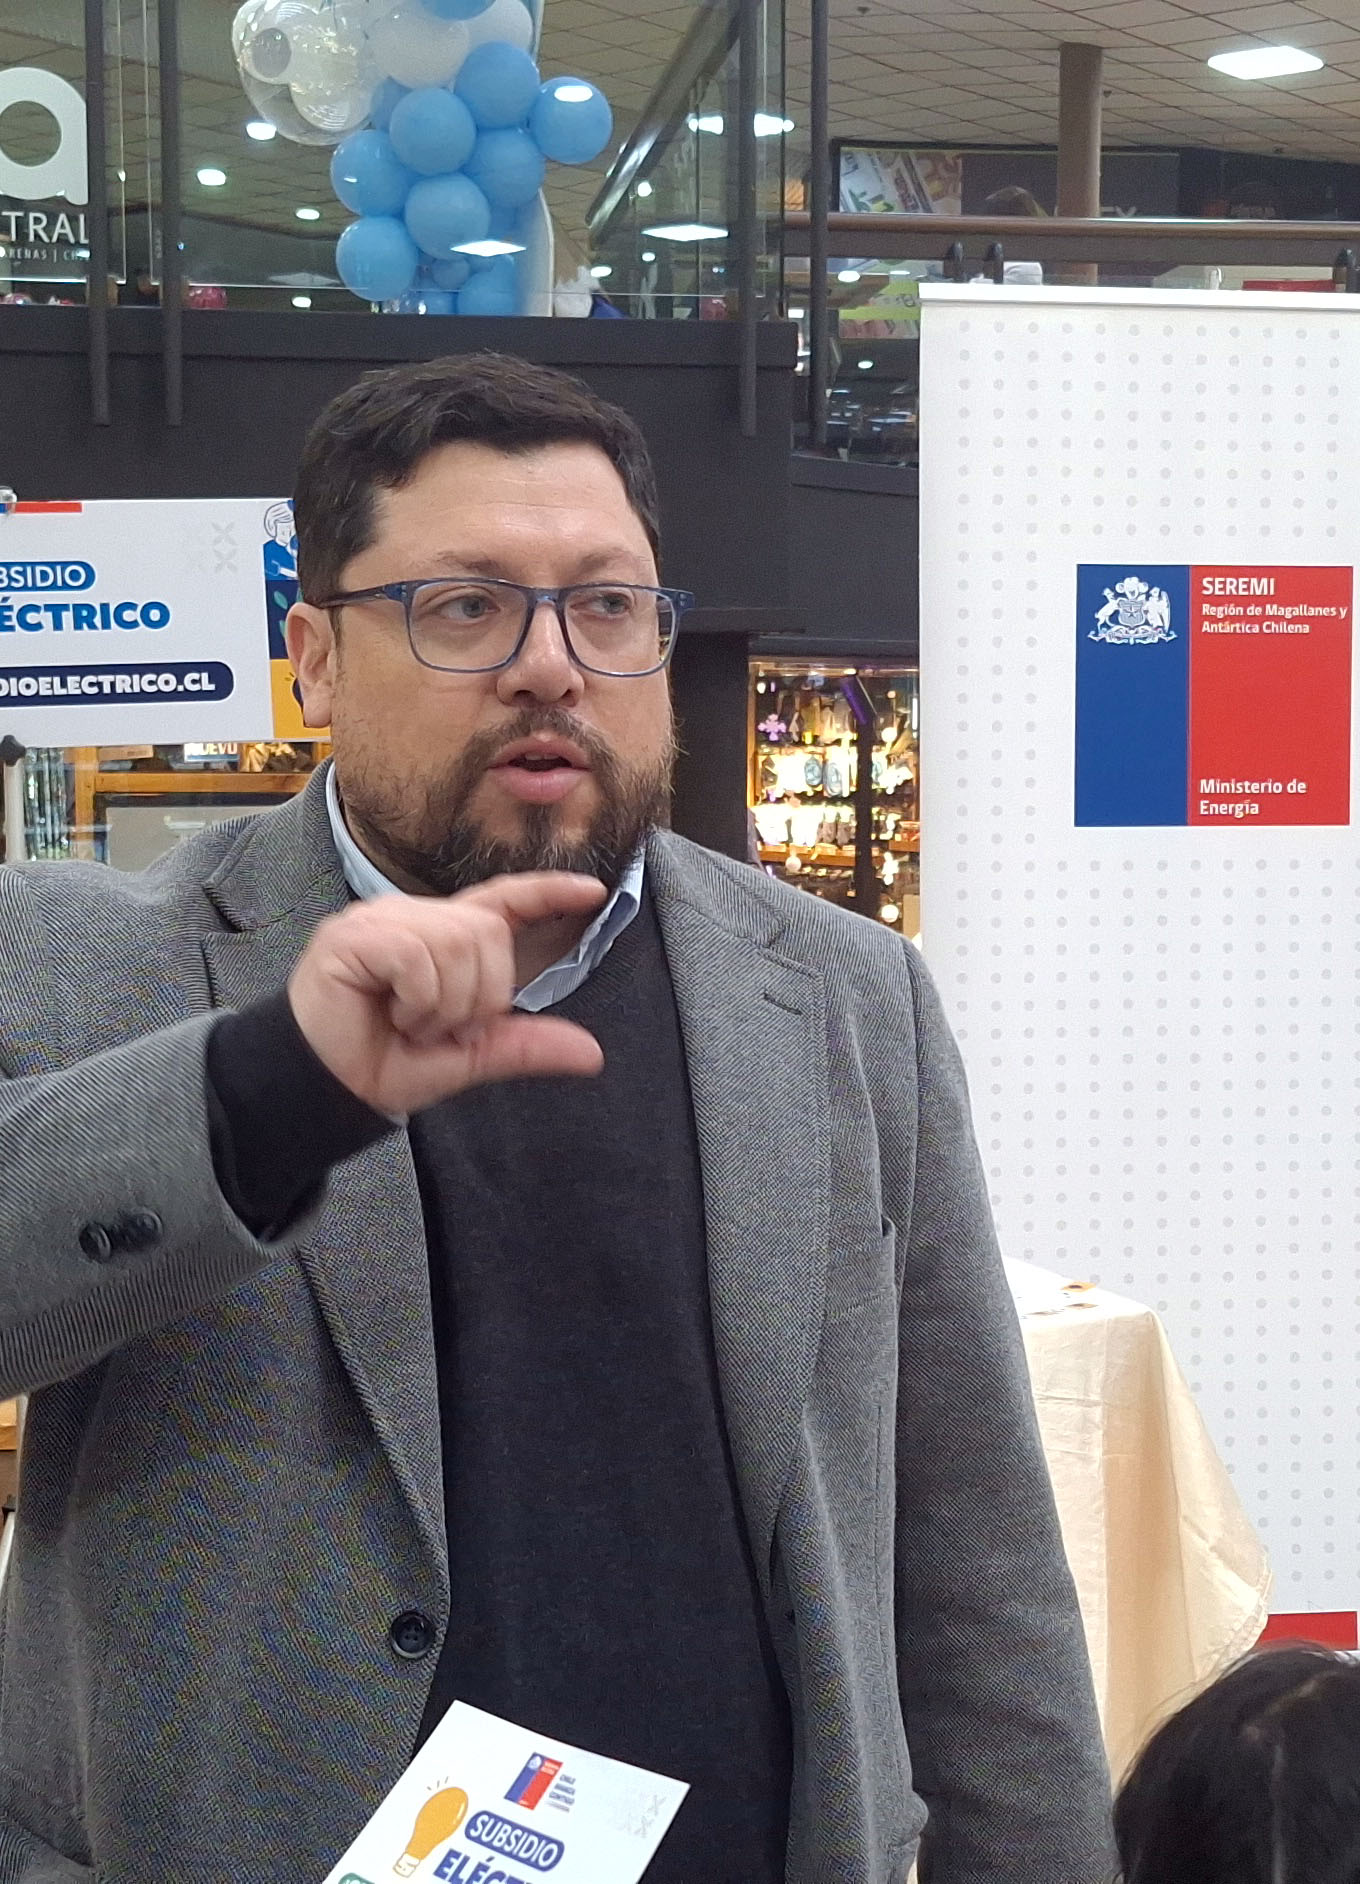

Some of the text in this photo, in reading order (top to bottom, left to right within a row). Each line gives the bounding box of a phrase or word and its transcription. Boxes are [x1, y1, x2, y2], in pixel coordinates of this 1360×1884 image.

[1201, 577, 1276, 596] SEREMI
[1202, 603, 1348, 620] Región de Magallanes y
[1201, 620, 1310, 634] Antártica Chilena
[1199, 778, 1307, 794] Ministerio de
[1199, 799, 1260, 818] Energía
[469, 1813, 559, 1869] SUBSIDIO
